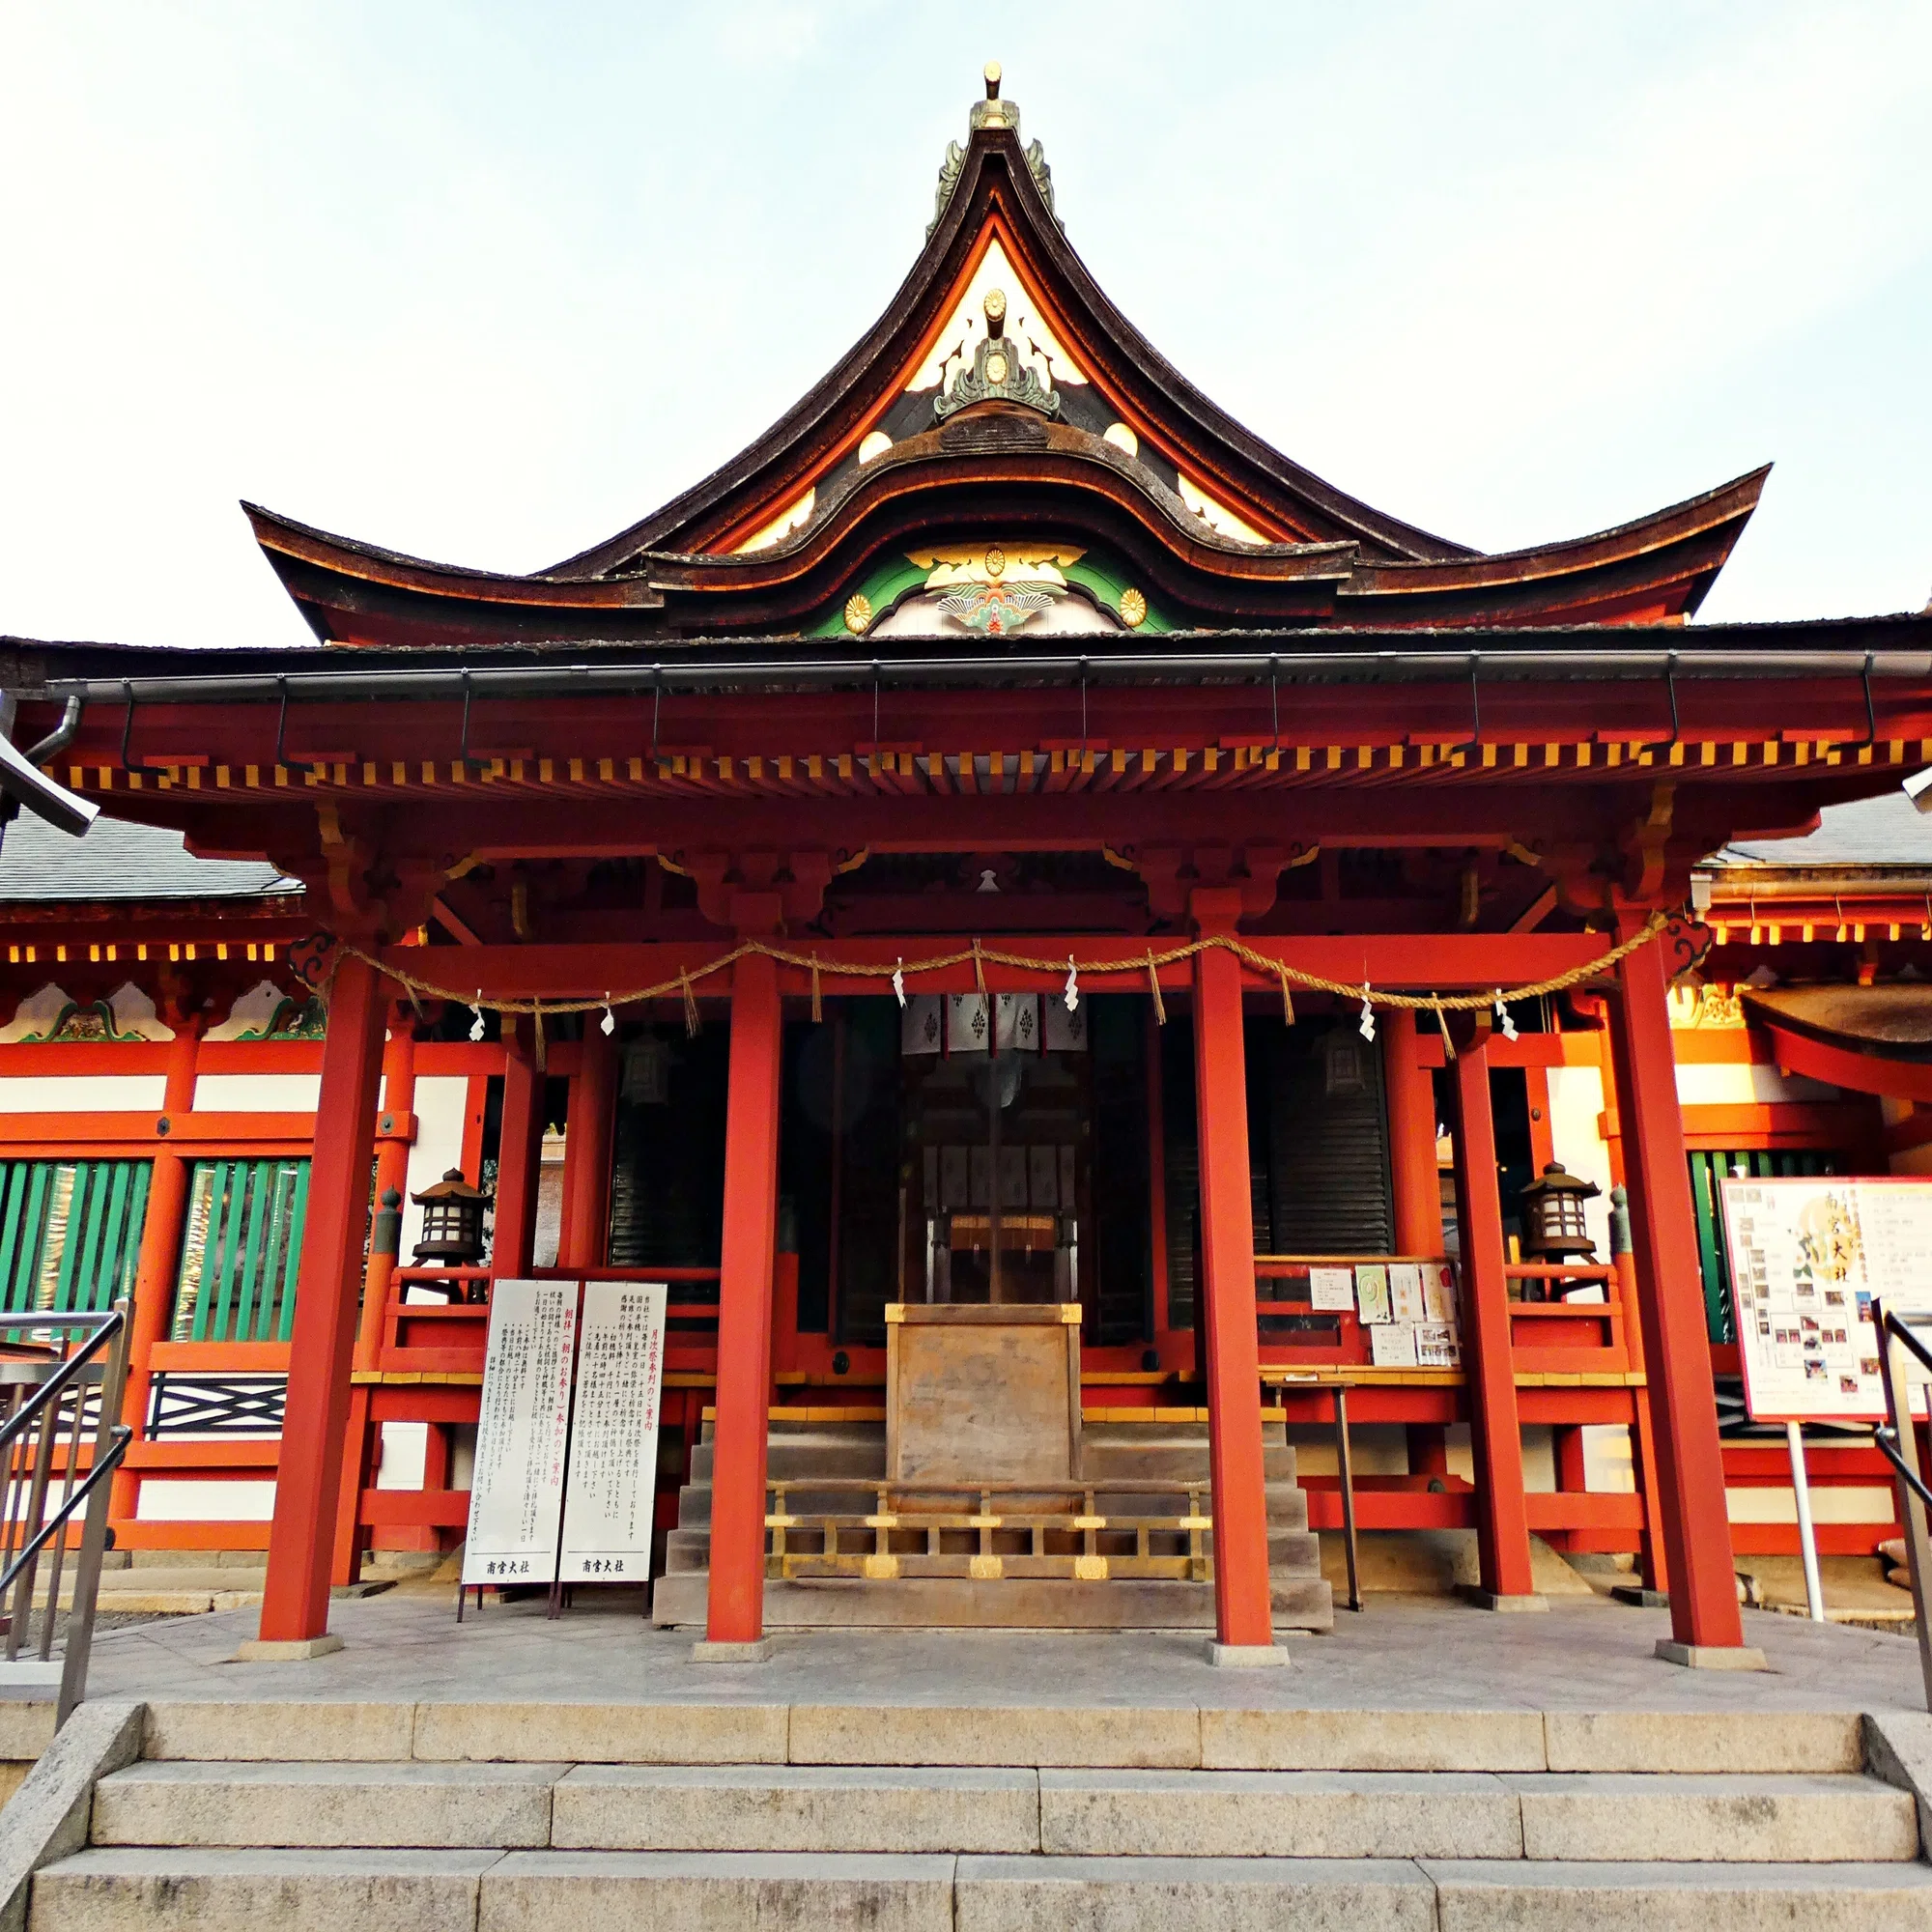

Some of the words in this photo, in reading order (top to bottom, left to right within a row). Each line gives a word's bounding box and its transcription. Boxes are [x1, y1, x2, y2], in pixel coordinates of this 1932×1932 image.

[1825, 1190, 1850, 1283] 南宮大社
[550, 1308, 574, 1486] 朝拝（朝のお参り）参加のご案内
[643, 1328, 659, 1431] 月次祭参列のご案内
[485, 1559, 530, 1575] 南宮大社
[581, 1558, 624, 1573] 南宮大社
